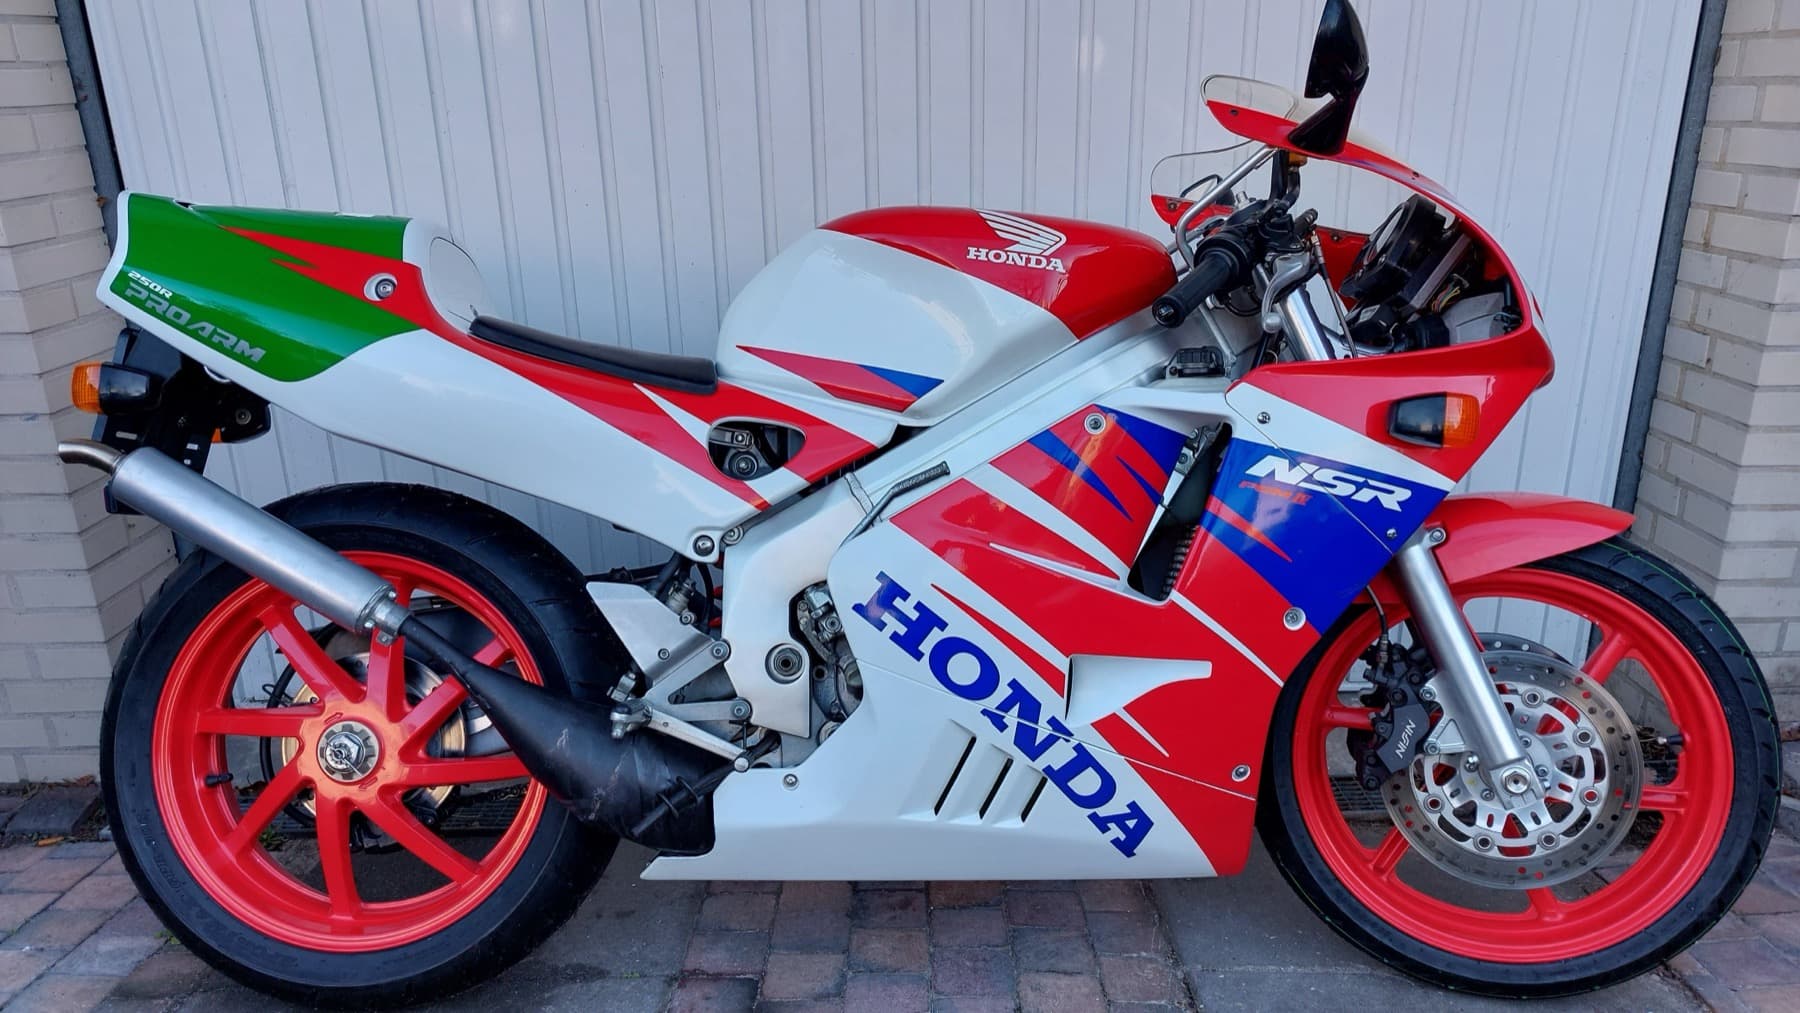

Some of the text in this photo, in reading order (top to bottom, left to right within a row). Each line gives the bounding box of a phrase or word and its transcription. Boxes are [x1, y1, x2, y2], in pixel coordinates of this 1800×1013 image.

[127, 270, 173, 299] 250R
[966, 246, 1066, 274] HONDA
[124, 281, 267, 363] PRO ARM
[1245, 454, 1413, 513] NSR
[851, 570, 1155, 858] HONDA
